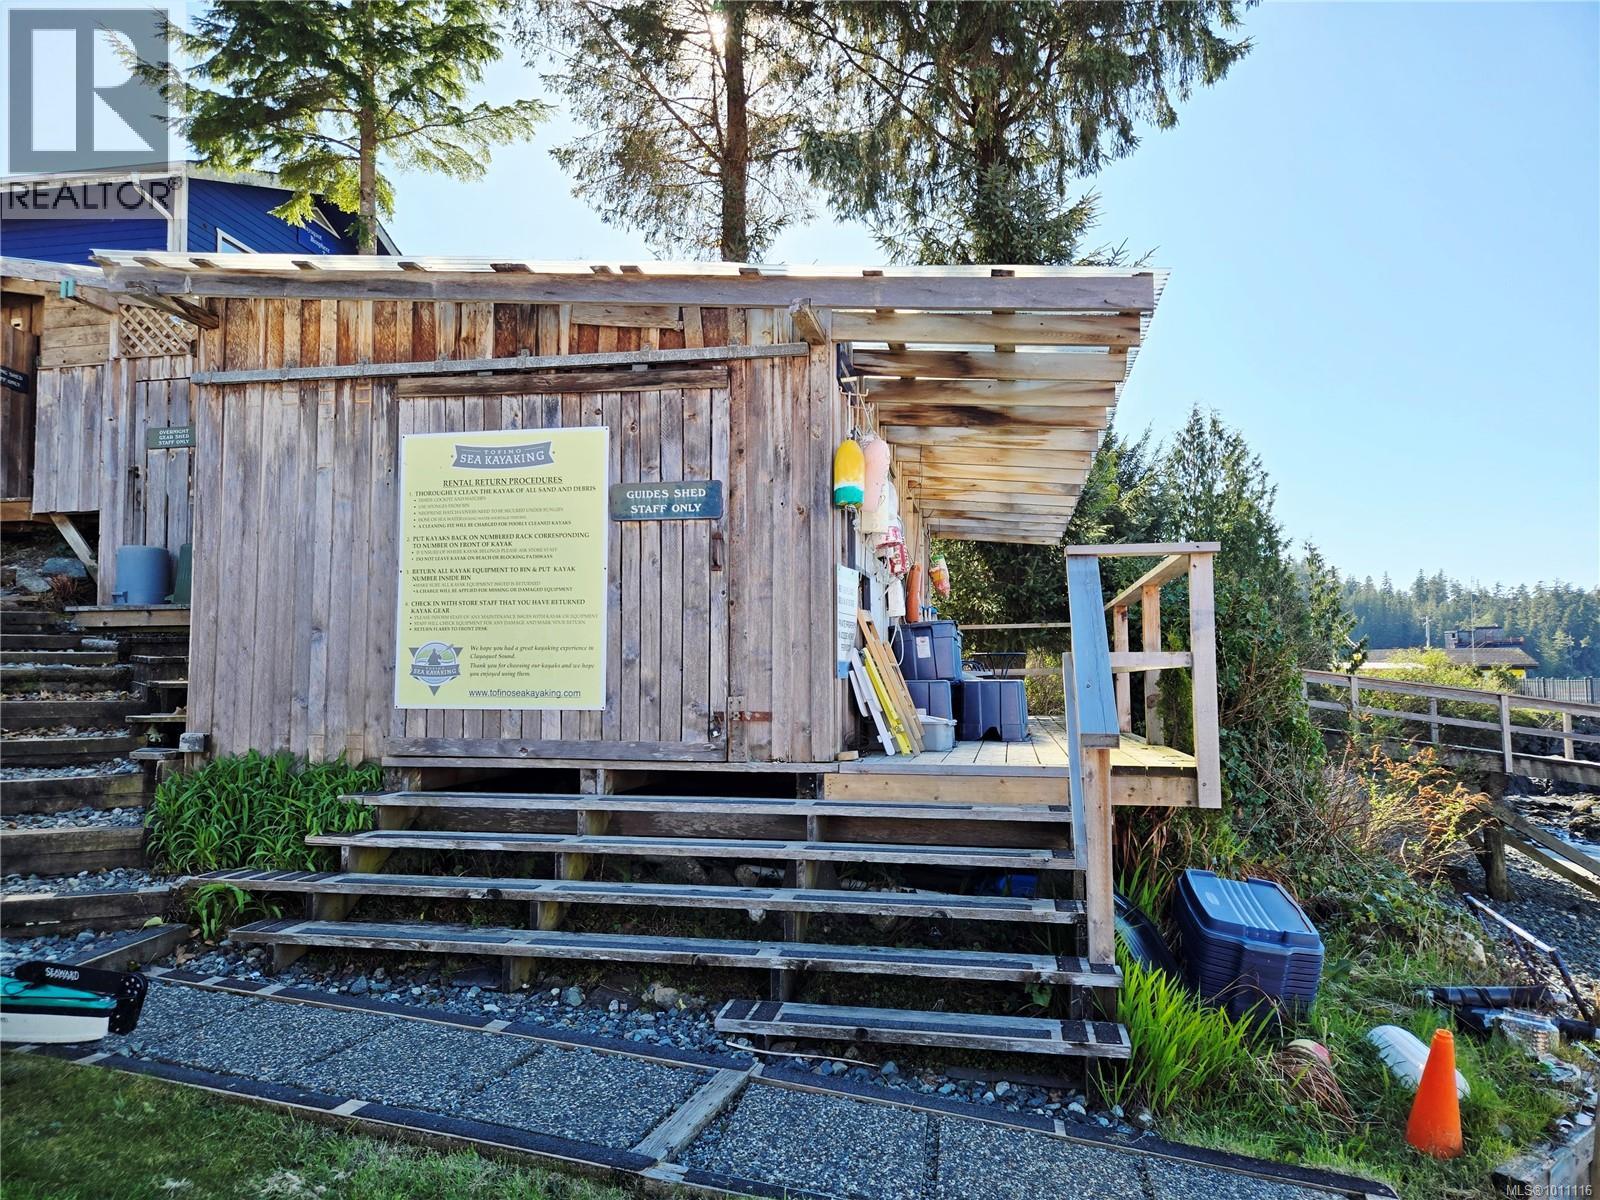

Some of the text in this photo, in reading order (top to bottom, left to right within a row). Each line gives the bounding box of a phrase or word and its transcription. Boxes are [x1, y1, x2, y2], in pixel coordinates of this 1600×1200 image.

[460, 450, 544, 464] SEA KAYAKING
[509, 477, 563, 485] PROCEDURES
[626, 488, 706, 499] GUIDES SHED
[630, 503, 702, 514] STAFF ONLY
[469, 689, 581, 698] www.tofinoseakayaking.com
[44, 967, 80, 981] SEAWARD
